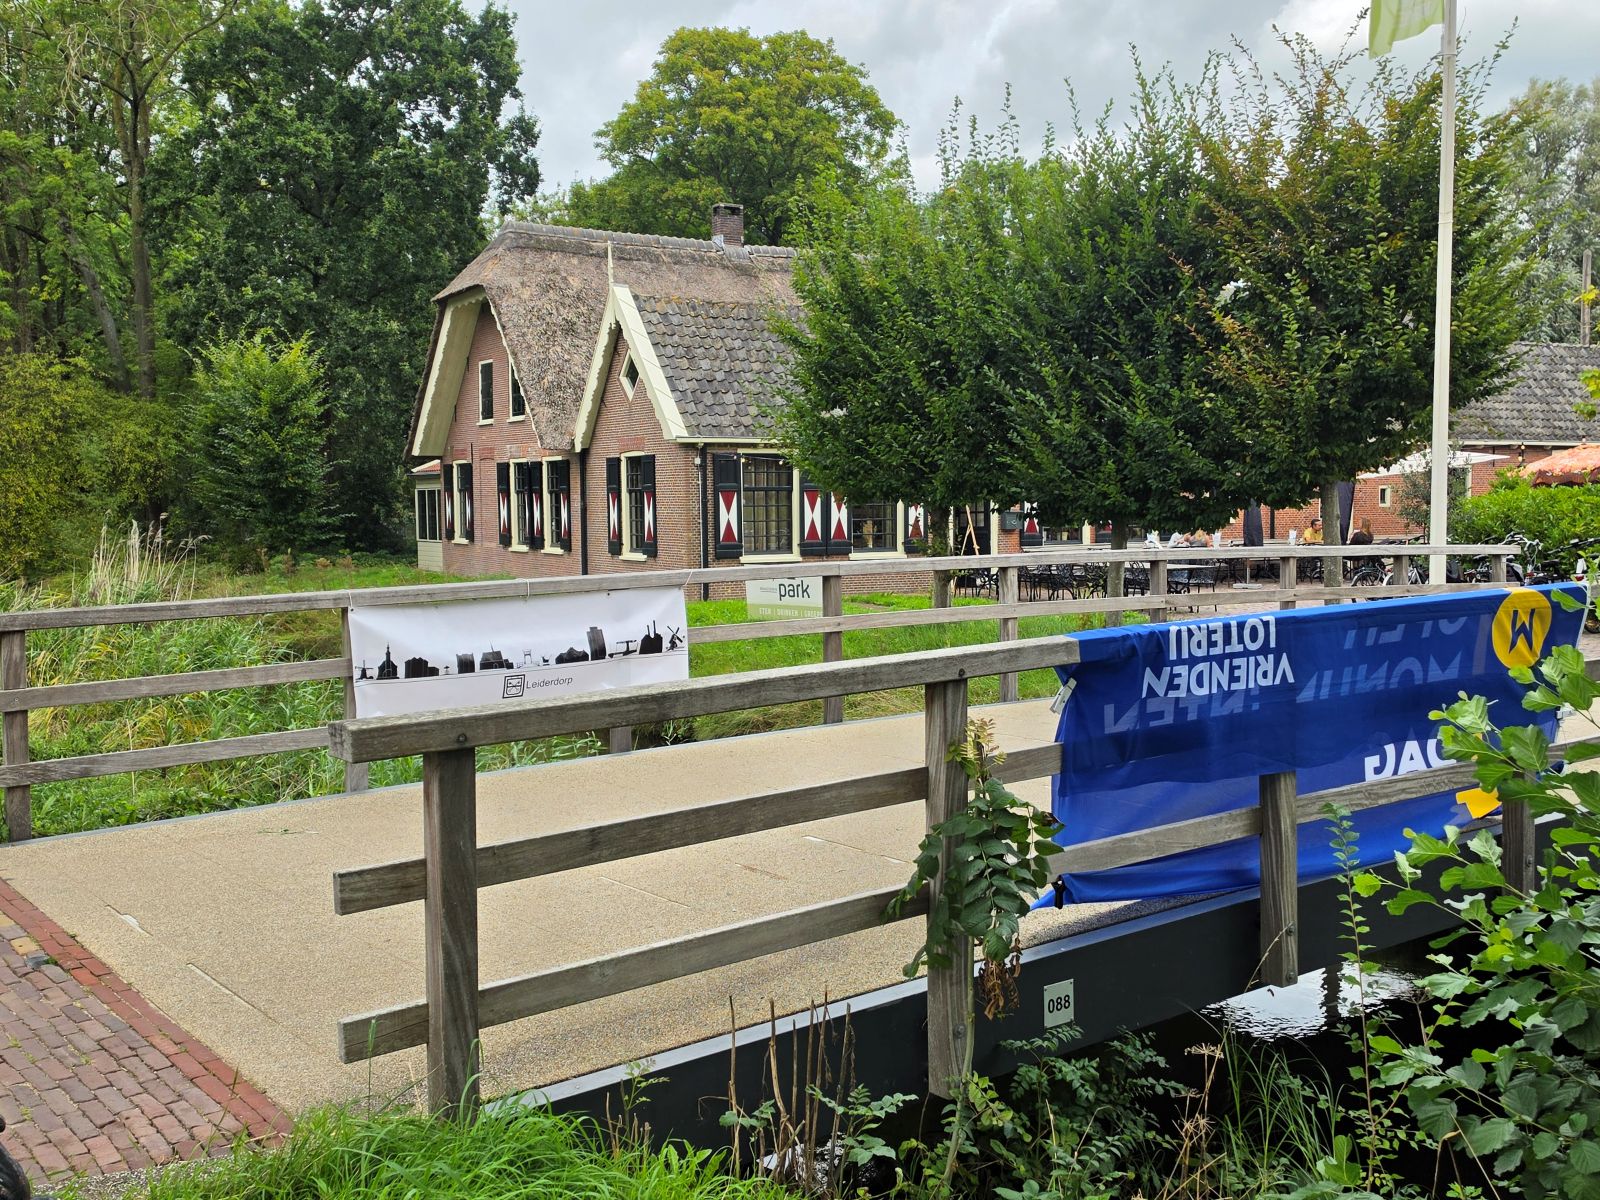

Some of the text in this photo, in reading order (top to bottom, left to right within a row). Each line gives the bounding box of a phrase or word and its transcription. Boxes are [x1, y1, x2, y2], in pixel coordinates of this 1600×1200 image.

[778, 580, 811, 601] park
[526, 677, 573, 689] Leiderdorp
[1142, 652, 1295, 699] VRIENDEN
[1047, 994, 1071, 1014] 088
